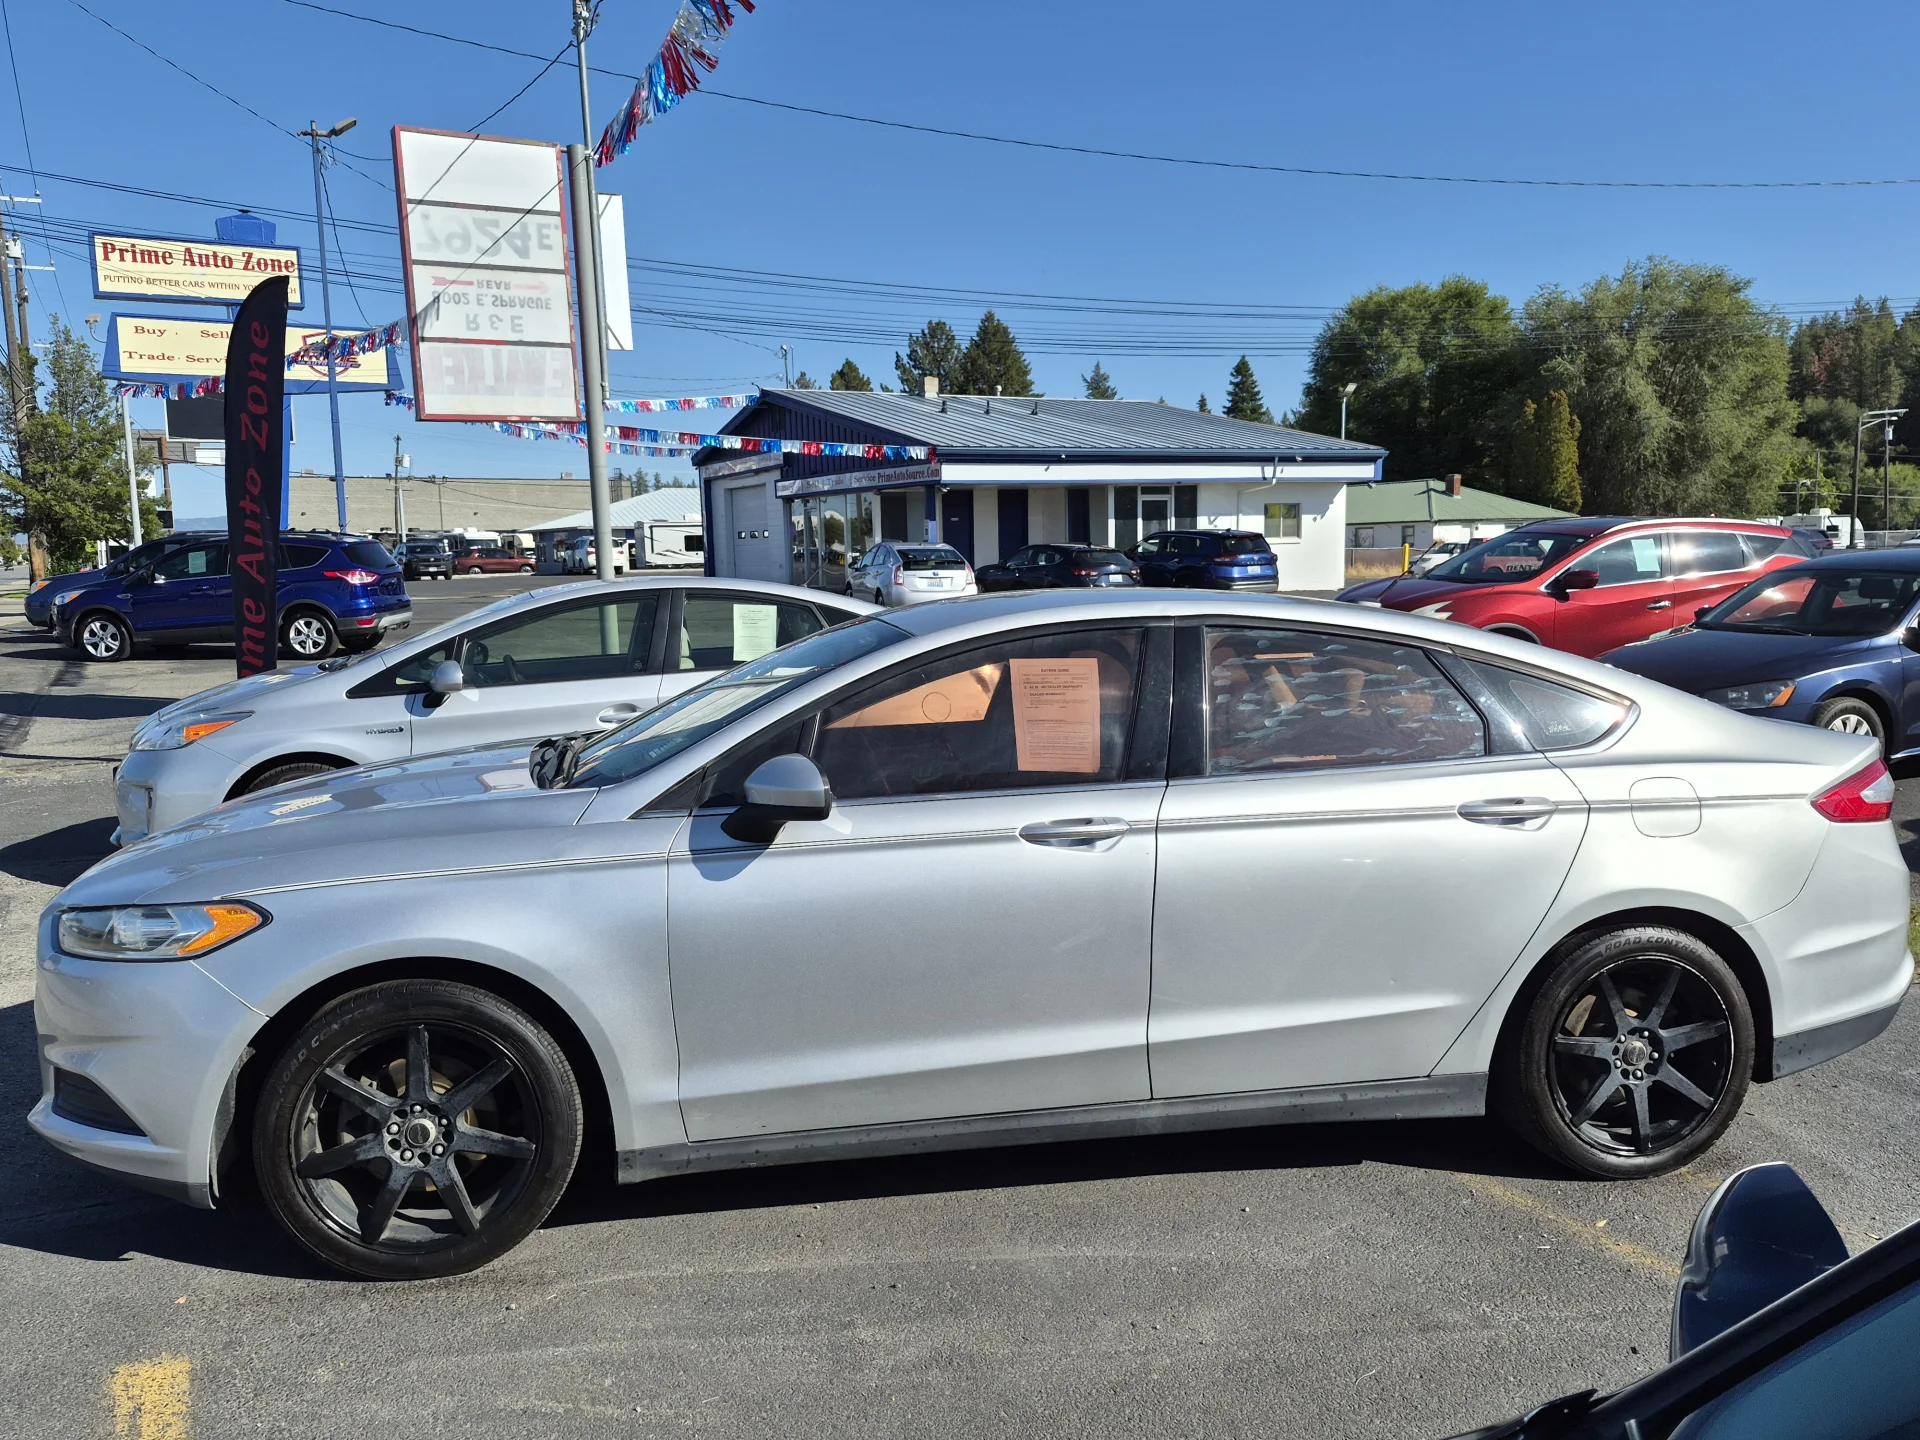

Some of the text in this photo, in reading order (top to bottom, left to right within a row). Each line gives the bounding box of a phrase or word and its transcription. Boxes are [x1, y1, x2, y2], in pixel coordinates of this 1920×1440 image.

[101, 242, 296, 274] Prime Auto Zone
[103, 274, 143, 285] PUTTING
[146, 277, 181, 287] BETTER
[182, 279, 206, 289] CARS
[208, 281, 240, 291] WITHIN
[133, 325, 230, 339] Buy Sell
[122, 350, 227, 364] Trade Servi
[240, 320, 270, 453] Zone
[854, 474, 876, 484] Service
[877, 466, 940, 483] PrimeAutoSource.Com
[236, 466, 266, 585] Auto
[1604, 936, 1642, 953] ROAD
